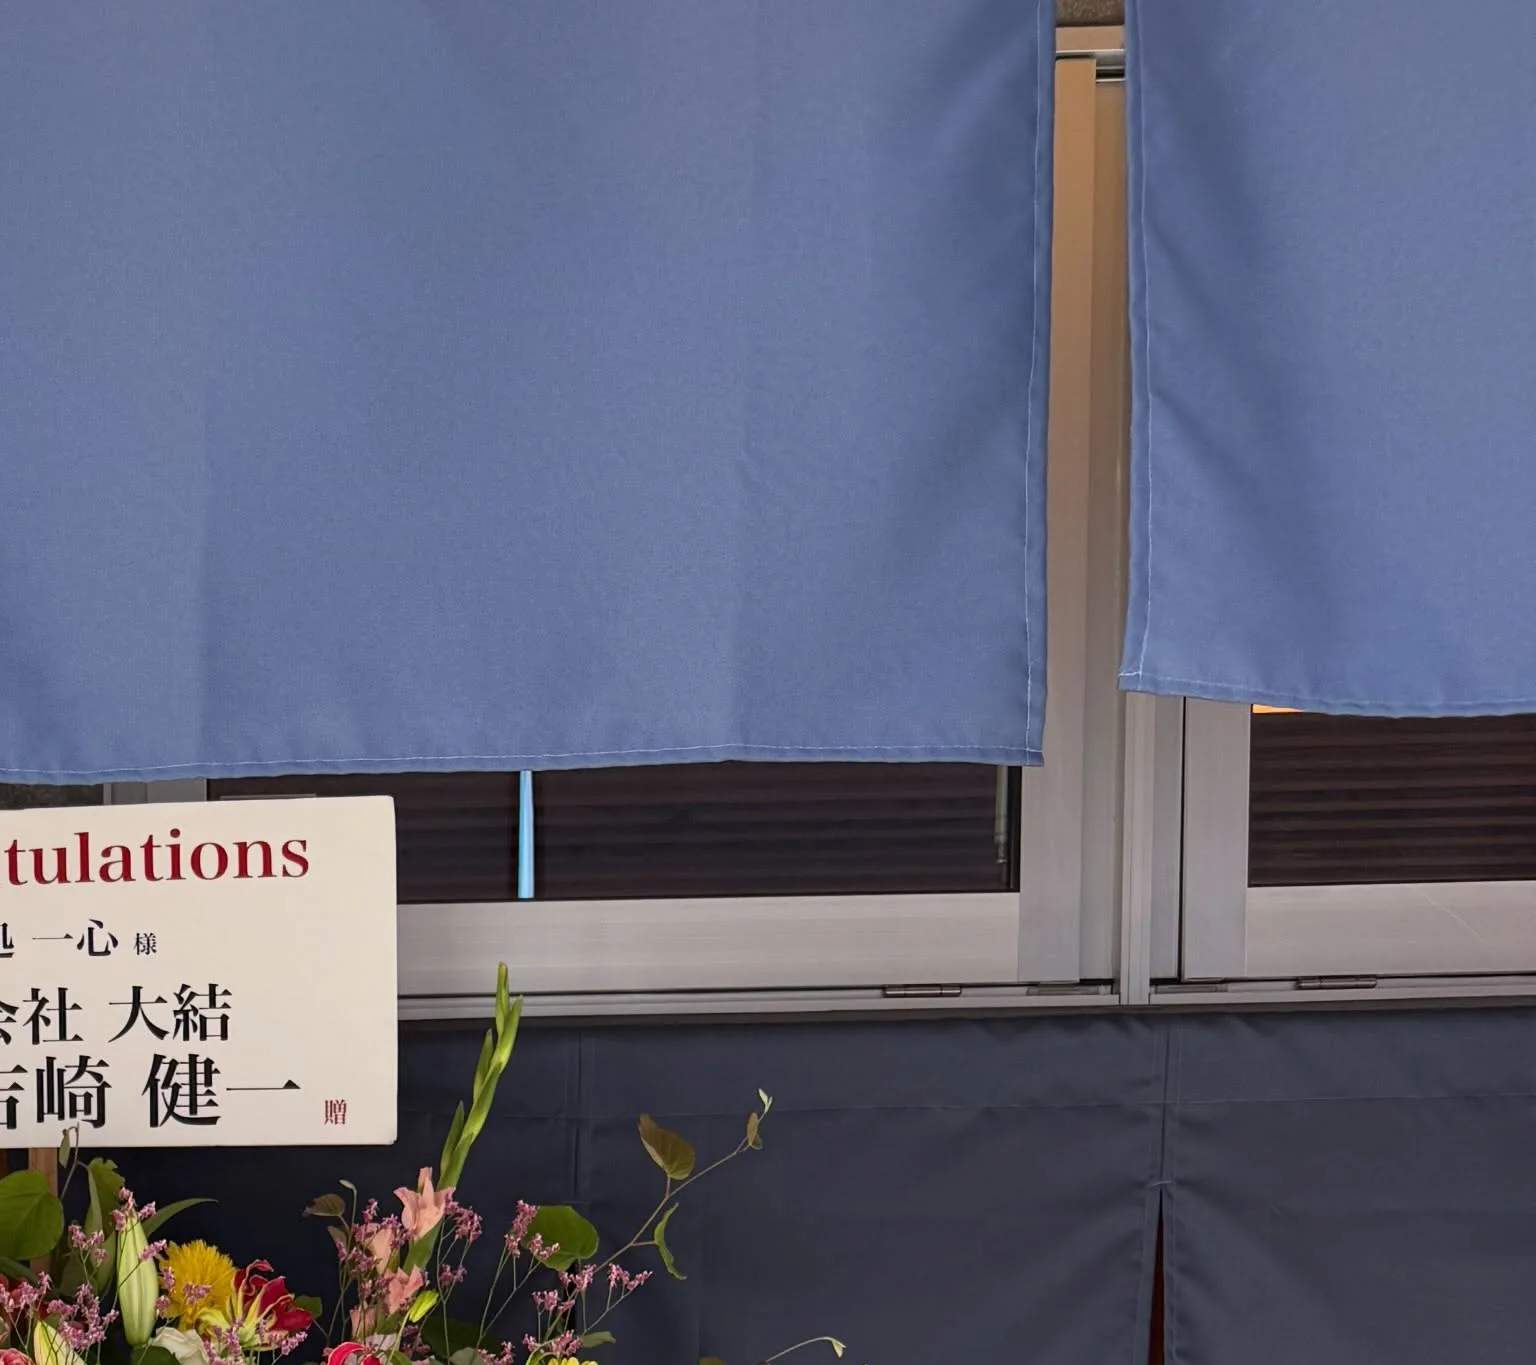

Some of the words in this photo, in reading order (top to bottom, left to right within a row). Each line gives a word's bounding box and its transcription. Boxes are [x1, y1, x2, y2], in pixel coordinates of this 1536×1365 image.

[31, 919, 119, 957] 一心
[134, 932, 157, 956] 様
[108, 983, 233, 1043] 大結
[141, 1052, 301, 1128] 健一
[323, 1099, 348, 1126] 贈
